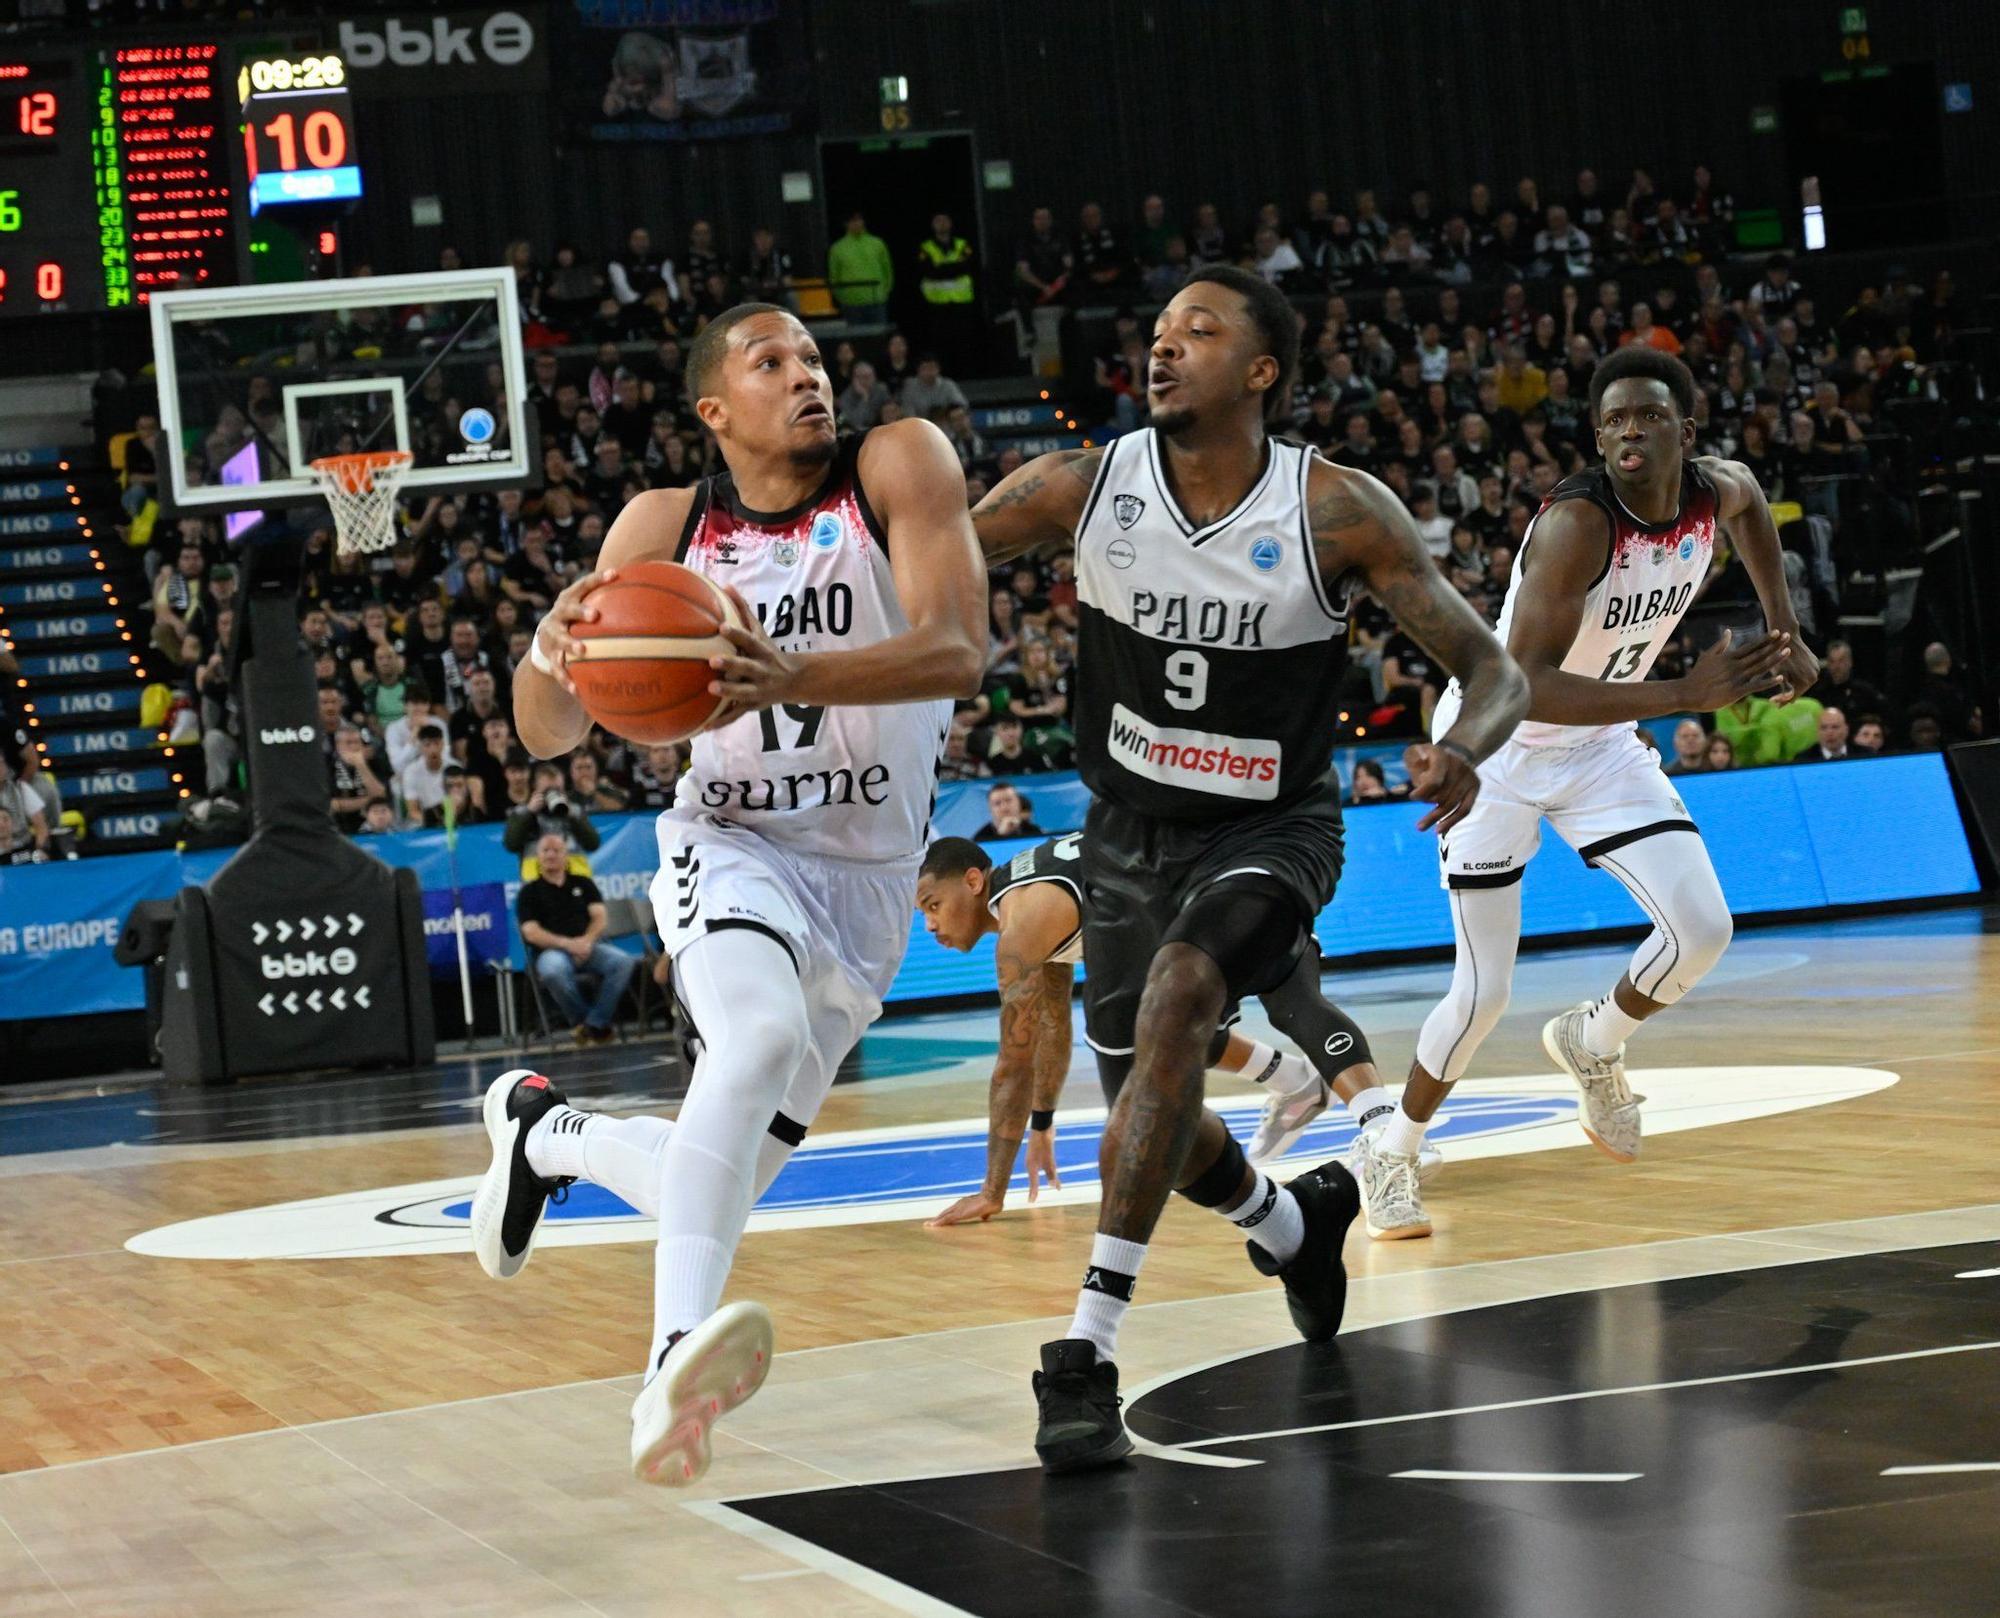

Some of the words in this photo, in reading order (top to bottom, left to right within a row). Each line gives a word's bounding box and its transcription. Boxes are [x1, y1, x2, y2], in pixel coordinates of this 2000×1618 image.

[251, 56, 344, 91] 09:26
[21, 93, 55, 135] 12
[265, 111, 346, 171] 10
[38, 263, 61, 299] 0
[1130, 587, 1269, 648] PAOK
[1603, 582, 1692, 630] BILBAO
[48, 653, 100, 674] IMQ
[1599, 641, 1651, 681] 13
[1164, 650, 1209, 711] 9
[60, 692, 113, 714] IMQ
[74, 731, 129, 752] IMQ
[261, 729, 298, 745] bbk
[1111, 718, 1278, 783] winmasters
[80, 772, 137, 795] IMQ
[701, 764, 890, 811] surne
[102, 815, 158, 838] IMQ
[1475, 860, 1511, 870] CORREO
[23, 917, 120, 951] EUROPE
[261, 951, 329, 979] bbk
